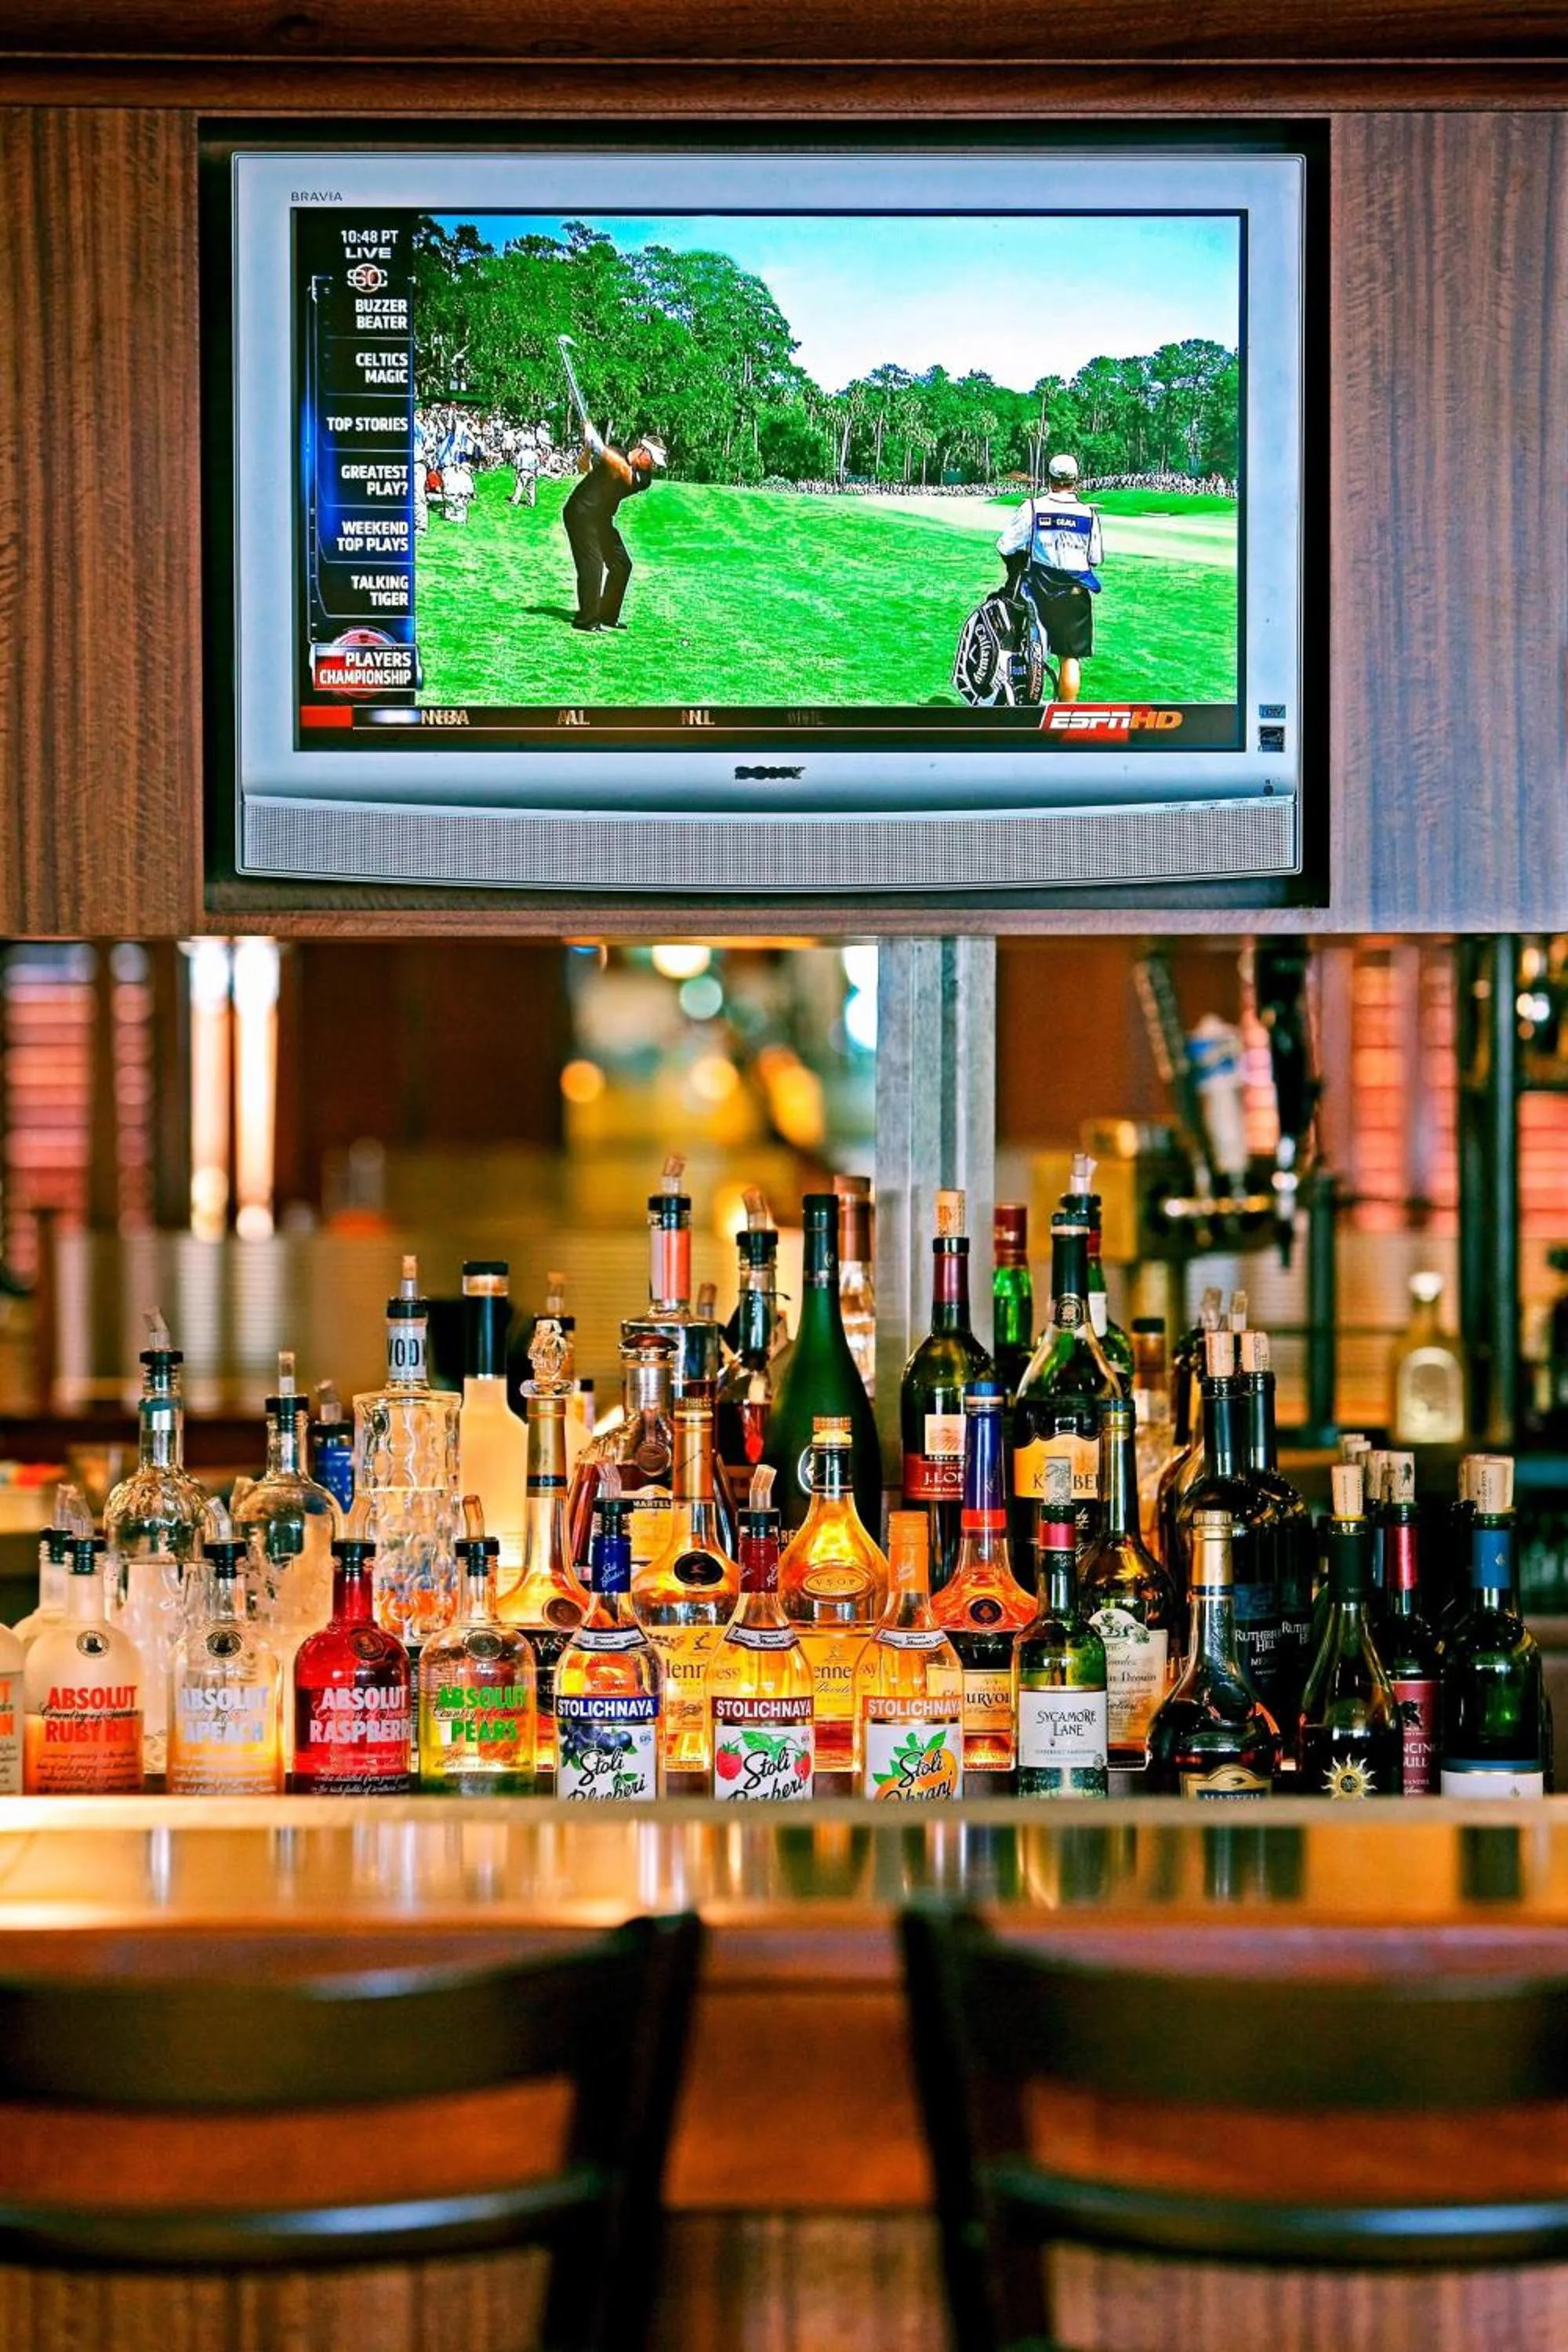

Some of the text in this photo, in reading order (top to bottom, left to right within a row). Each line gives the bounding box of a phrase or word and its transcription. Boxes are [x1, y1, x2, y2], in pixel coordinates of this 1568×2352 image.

[291, 191, 343, 201] BRAVIA
[340, 230, 398, 243] 10:48 PT
[345, 248, 391, 259] LIVE
[355, 299, 408, 313] BUZZER
[357, 315, 408, 329] BEATER
[355, 353, 408, 367] CELTICS
[365, 370, 408, 383] MAGIC
[326, 418, 408, 431] TOP STORIES
[341, 465, 408, 479] GREATEST
[366, 482, 408, 495] PLAY?
[342, 521, 408, 535] WEEKEND
[337, 538, 408, 552] TOP PLAYS
[351, 575, 408, 589] TALKING
[370, 593, 408, 606] TIGER
[345, 652, 412, 667] PLAYERS
[319, 670, 412, 684] CHAMPIONSHIP
[633, 1500, 672, 1509] MARTEL
[48, 1686, 137, 1710] ABSOLUT
[320, 1686, 407, 1710] ABSOLUT
[557, 1700, 654, 1718] STOLICHNAYA
[716, 1700, 811, 1718] STOLICHNAYA
[1036, 1709, 1097, 1724] SYCAMORE
[45, 1720, 102, 1742] RUBY
[451, 1720, 517, 1742] PEARS
[1053, 1724, 1084, 1737] LANE
[579, 1748, 625, 1787] Stoli
[743, 1748, 790, 1790] Stoli
[898, 1749, 942, 1788] Stoli
